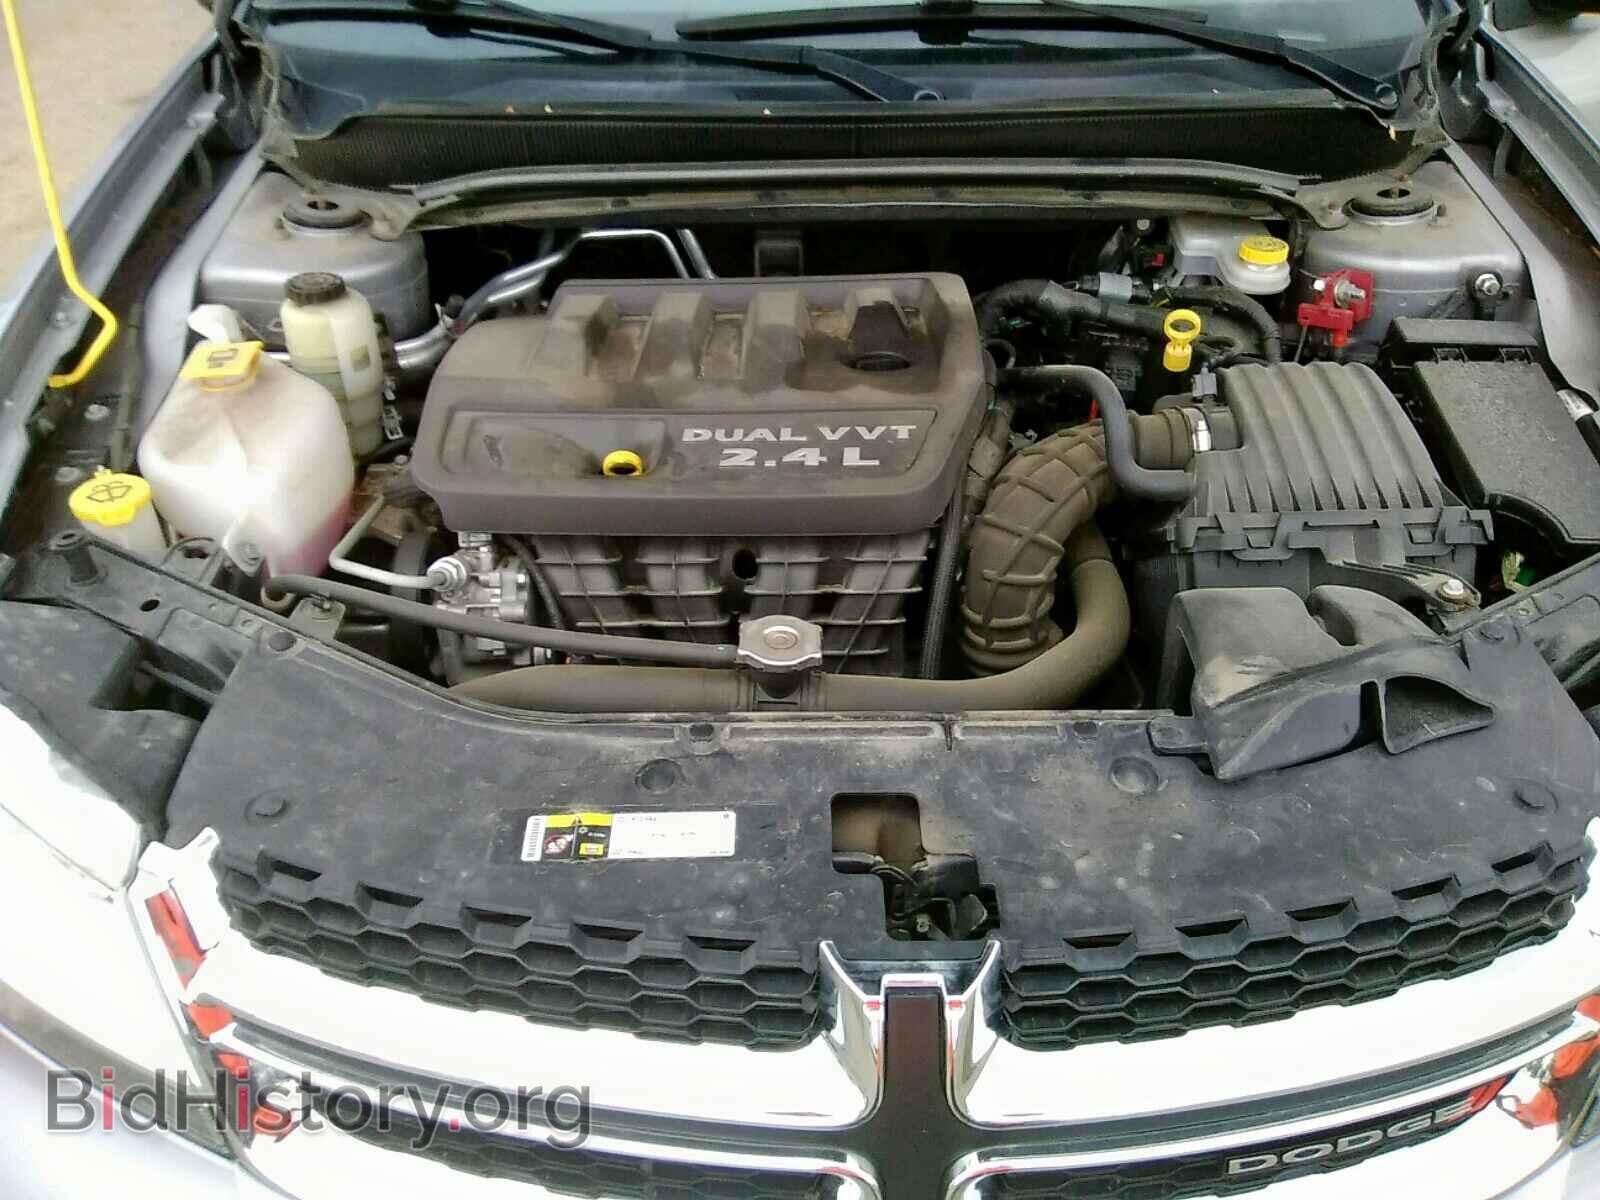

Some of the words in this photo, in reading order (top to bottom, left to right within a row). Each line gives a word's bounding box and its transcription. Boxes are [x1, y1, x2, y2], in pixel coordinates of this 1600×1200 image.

[682, 427, 808, 442] DUAL
[817, 425, 917, 440] VVT
[1227, 1100, 1474, 1175] DODGE
